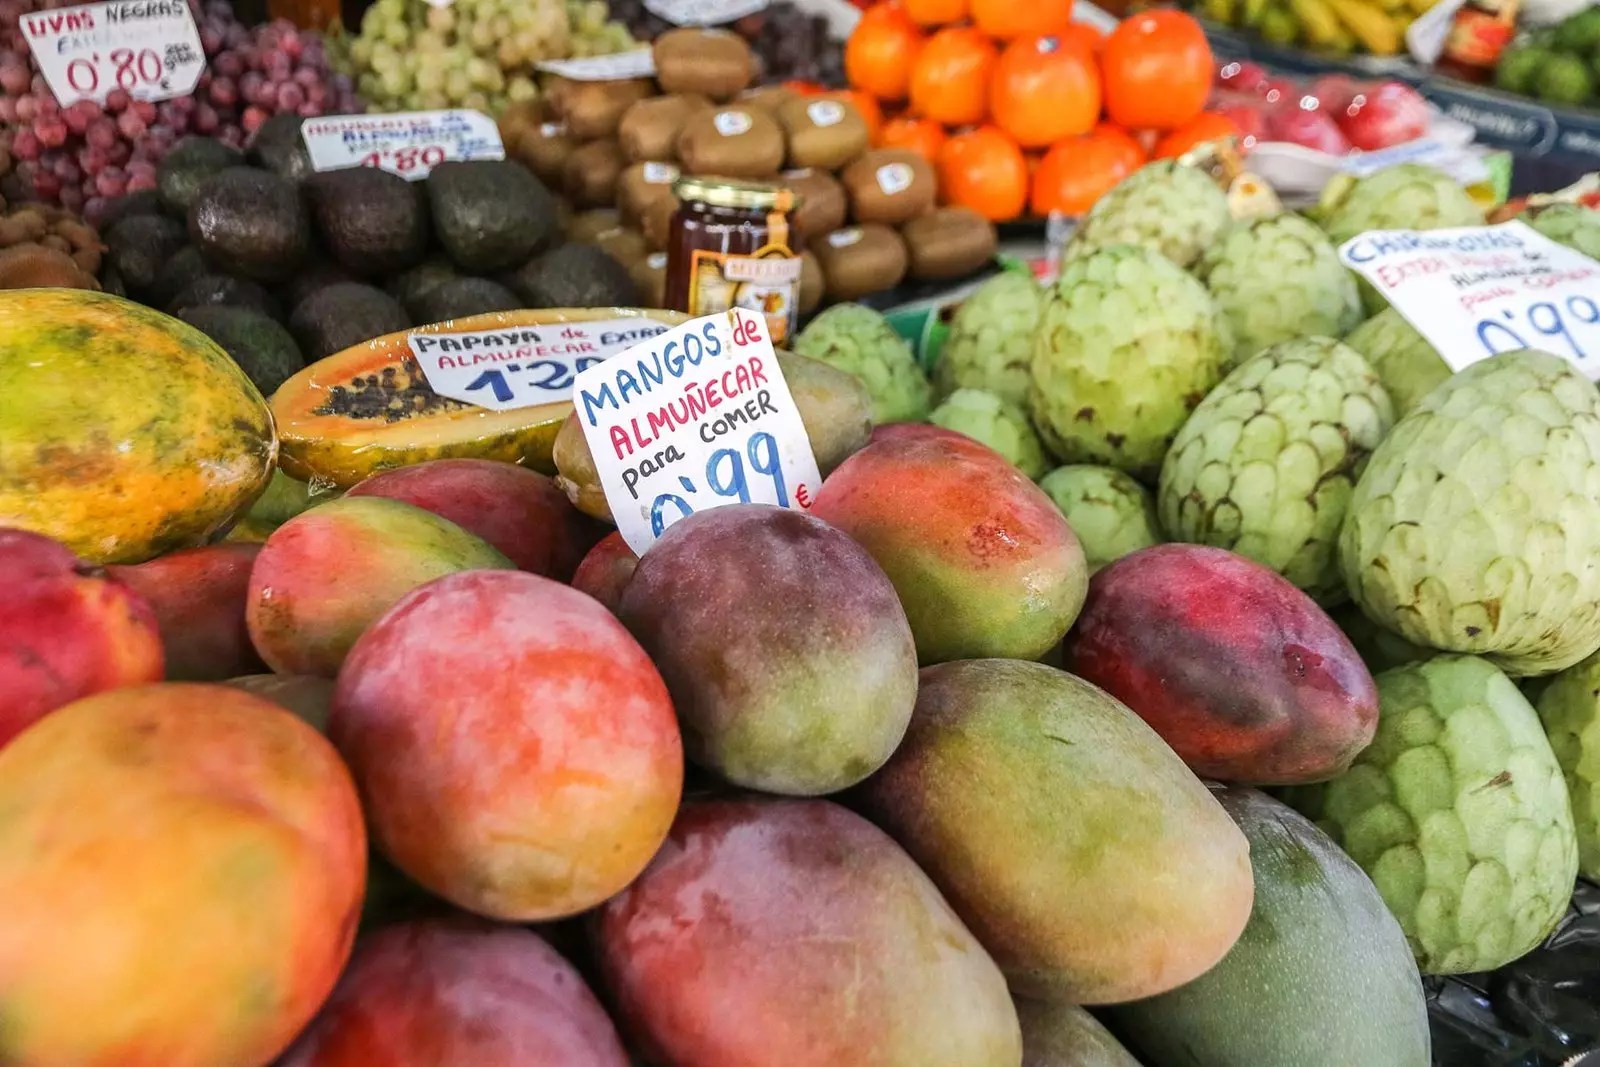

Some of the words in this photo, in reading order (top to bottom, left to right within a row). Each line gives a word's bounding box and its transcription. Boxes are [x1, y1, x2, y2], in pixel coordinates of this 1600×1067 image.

[27, 9, 95, 36] UVAS
[105, 1, 184, 24] NEGRAS
[67, 48, 162, 93] 0'80
[413, 330, 542, 353] PAPAYA
[560, 327, 588, 341] de
[600, 325, 669, 346] EXTRA
[438, 342, 595, 369] ALMUÑECAR
[580, 322, 722, 427] MANGOS
[733, 312, 762, 346] de
[609, 356, 768, 460] ALMUÑECAR
[621, 445, 685, 499] para
[699, 389, 779, 443] COMER
[795, 483, 812, 509] €
